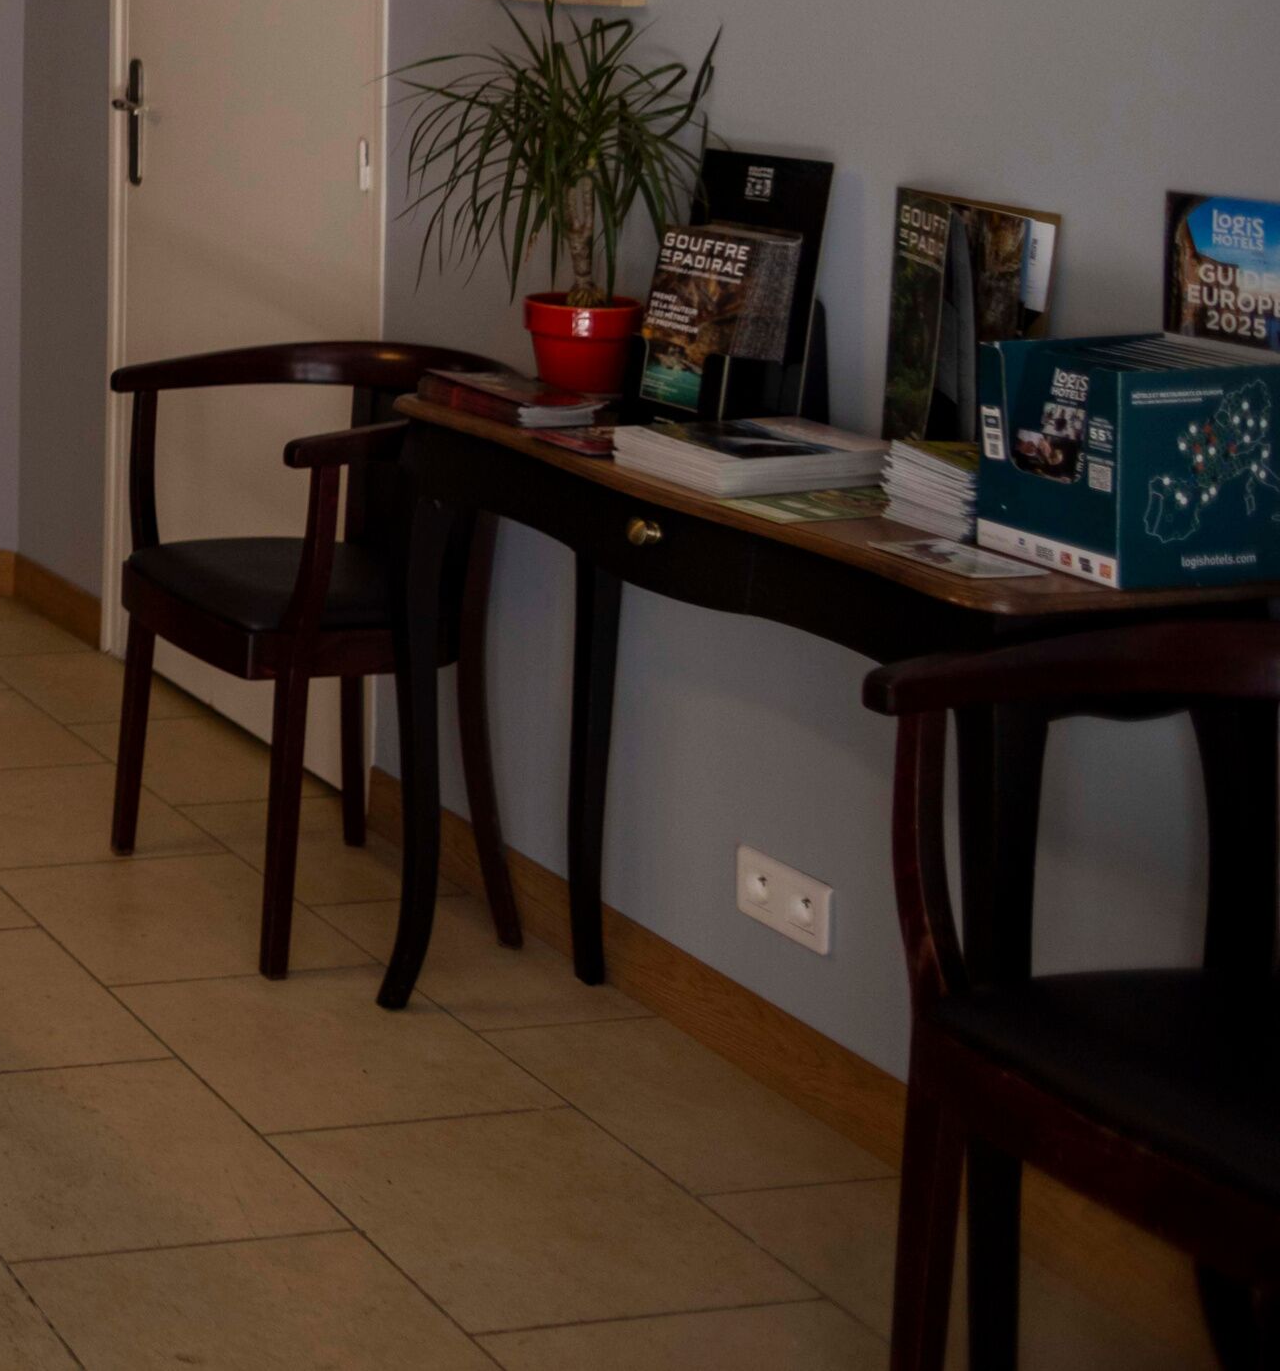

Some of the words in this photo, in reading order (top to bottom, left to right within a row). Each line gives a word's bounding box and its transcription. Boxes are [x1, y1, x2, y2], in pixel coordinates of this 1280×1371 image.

[663, 232, 751, 261] GOUFFRE
[1212, 233, 1265, 252] HOTELS
[672, 250, 746, 278] PADIRAC
[1199, 263, 1280, 294] GUIDE
[1206, 310, 1267, 339] 2025
[1050, 385, 1087, 403] HOTELS
[1180, 553, 1257, 570] logishotels.com
